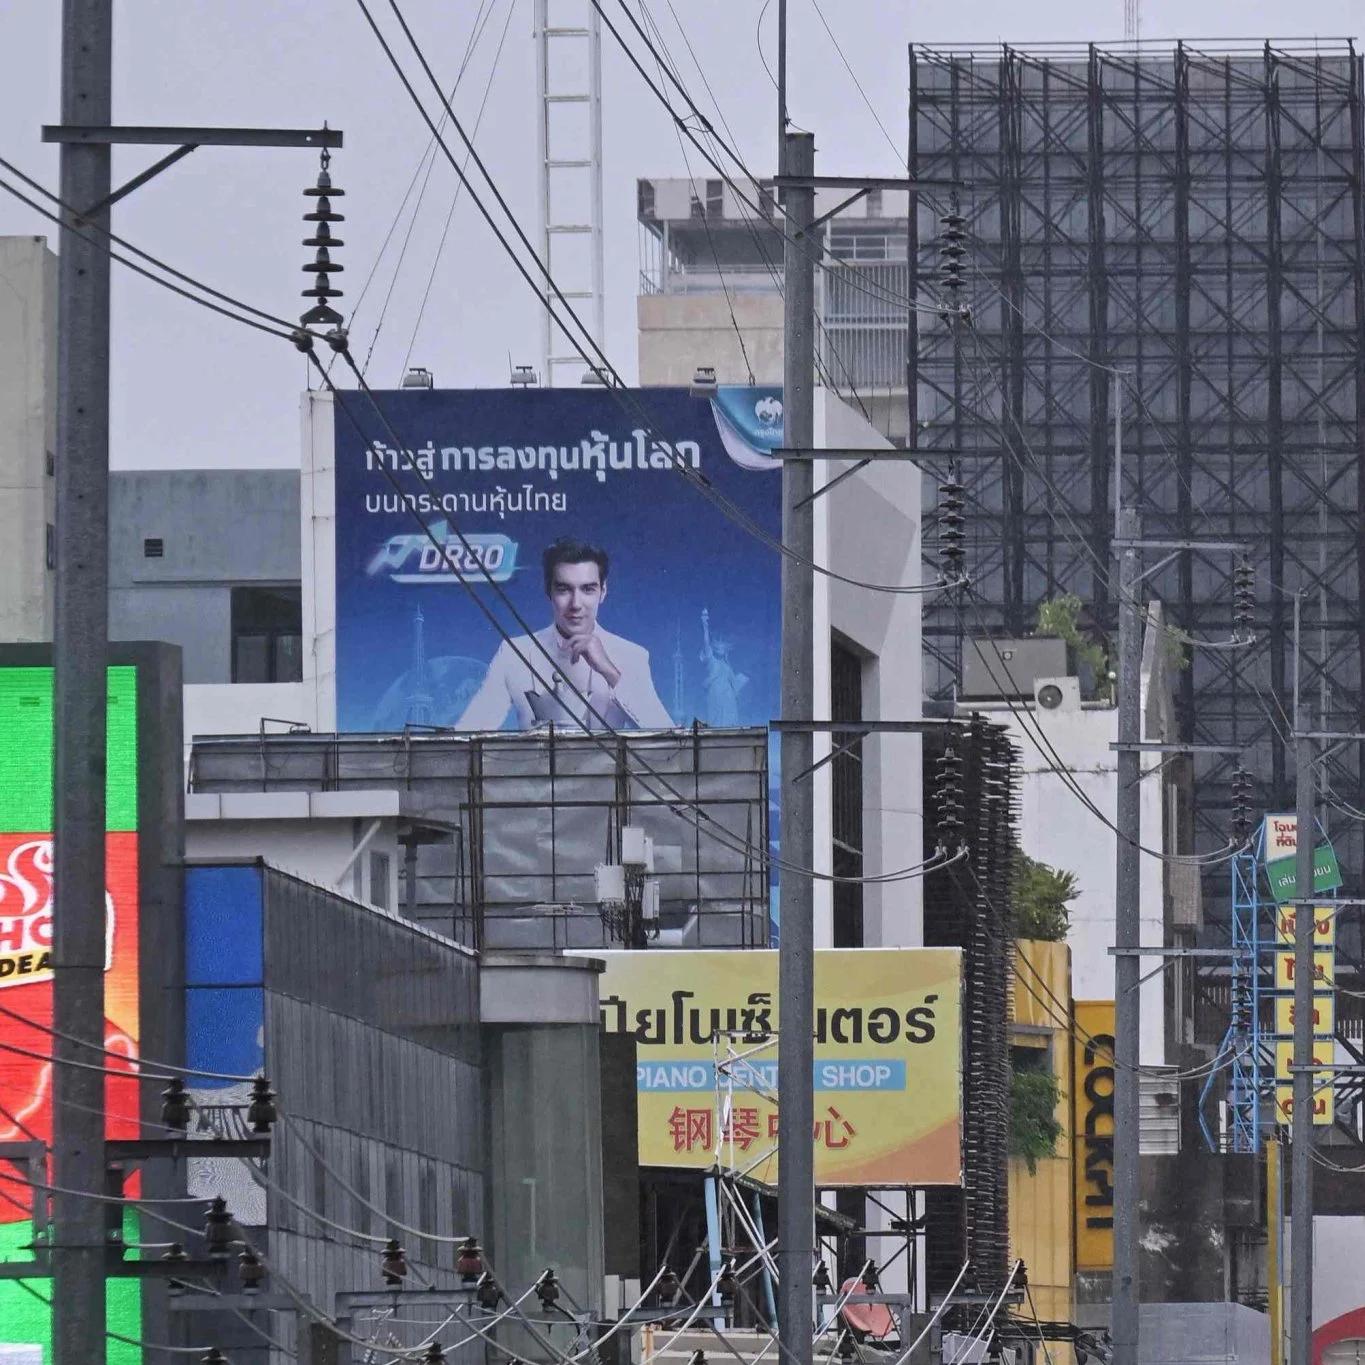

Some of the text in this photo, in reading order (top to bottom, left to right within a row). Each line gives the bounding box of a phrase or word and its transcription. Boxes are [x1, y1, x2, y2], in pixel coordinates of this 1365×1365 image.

[418, 542, 504, 573] DR80
[637, 1065, 891, 1088] PIANO CENT SHOP
